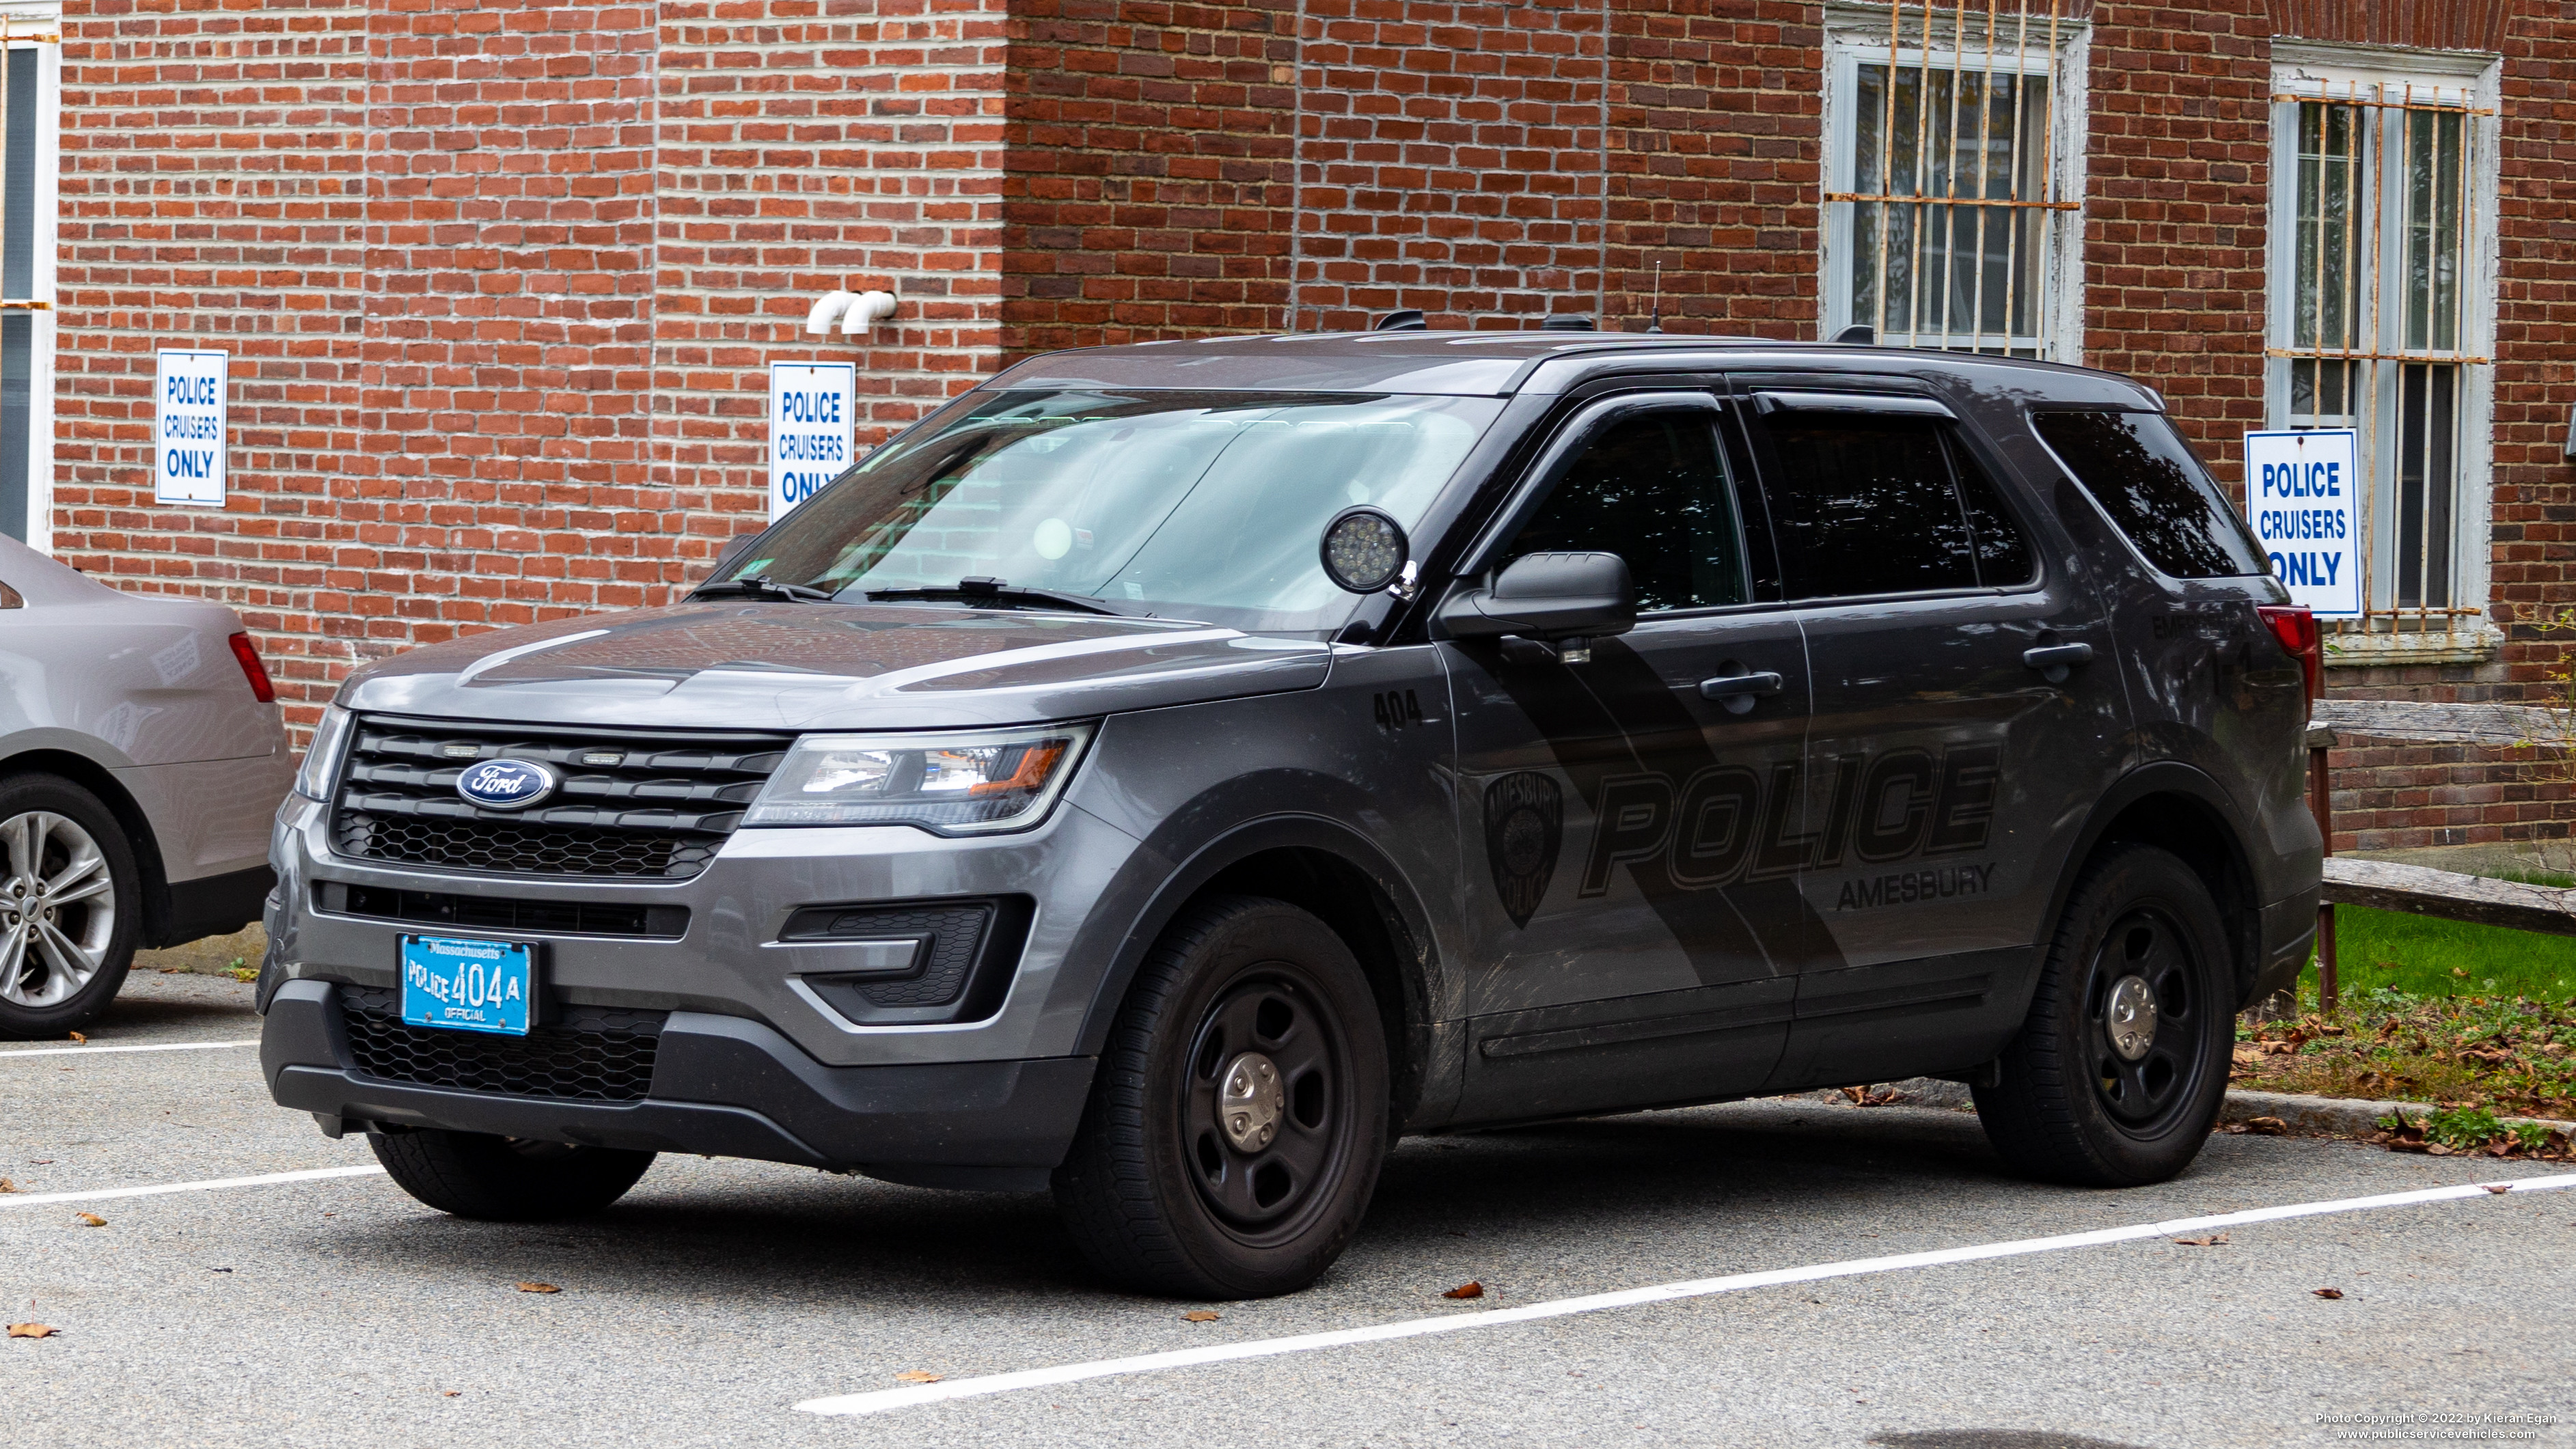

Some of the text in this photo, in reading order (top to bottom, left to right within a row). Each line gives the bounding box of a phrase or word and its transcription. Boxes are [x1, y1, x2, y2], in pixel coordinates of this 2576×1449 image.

[167, 376, 215, 404] POLICE
[782, 391, 841, 423] POLICE
[165, 414, 218, 440] CRUISERS
[167, 448, 214, 478] ONLY
[779, 434, 843, 462] CRUISERS
[2262, 461, 2340, 498] POLICE
[2260, 508, 2346, 540] CRUISERS
[2268, 551, 2342, 586] ONLY
[1374, 689, 1423, 730] 404
[471, 764, 527, 795] Ford
[1488, 772, 1559, 838] AMESBURY
[1578, 741, 2004, 899] POLICE
[1498, 858, 1550, 917] POLICE
[1836, 862, 1996, 911] AMESBURY
[429, 941, 501, 960] Massachusetts
[408, 959, 521, 1010] POLICE 404 A
[444, 1006, 487, 1022] OFFICIAL
